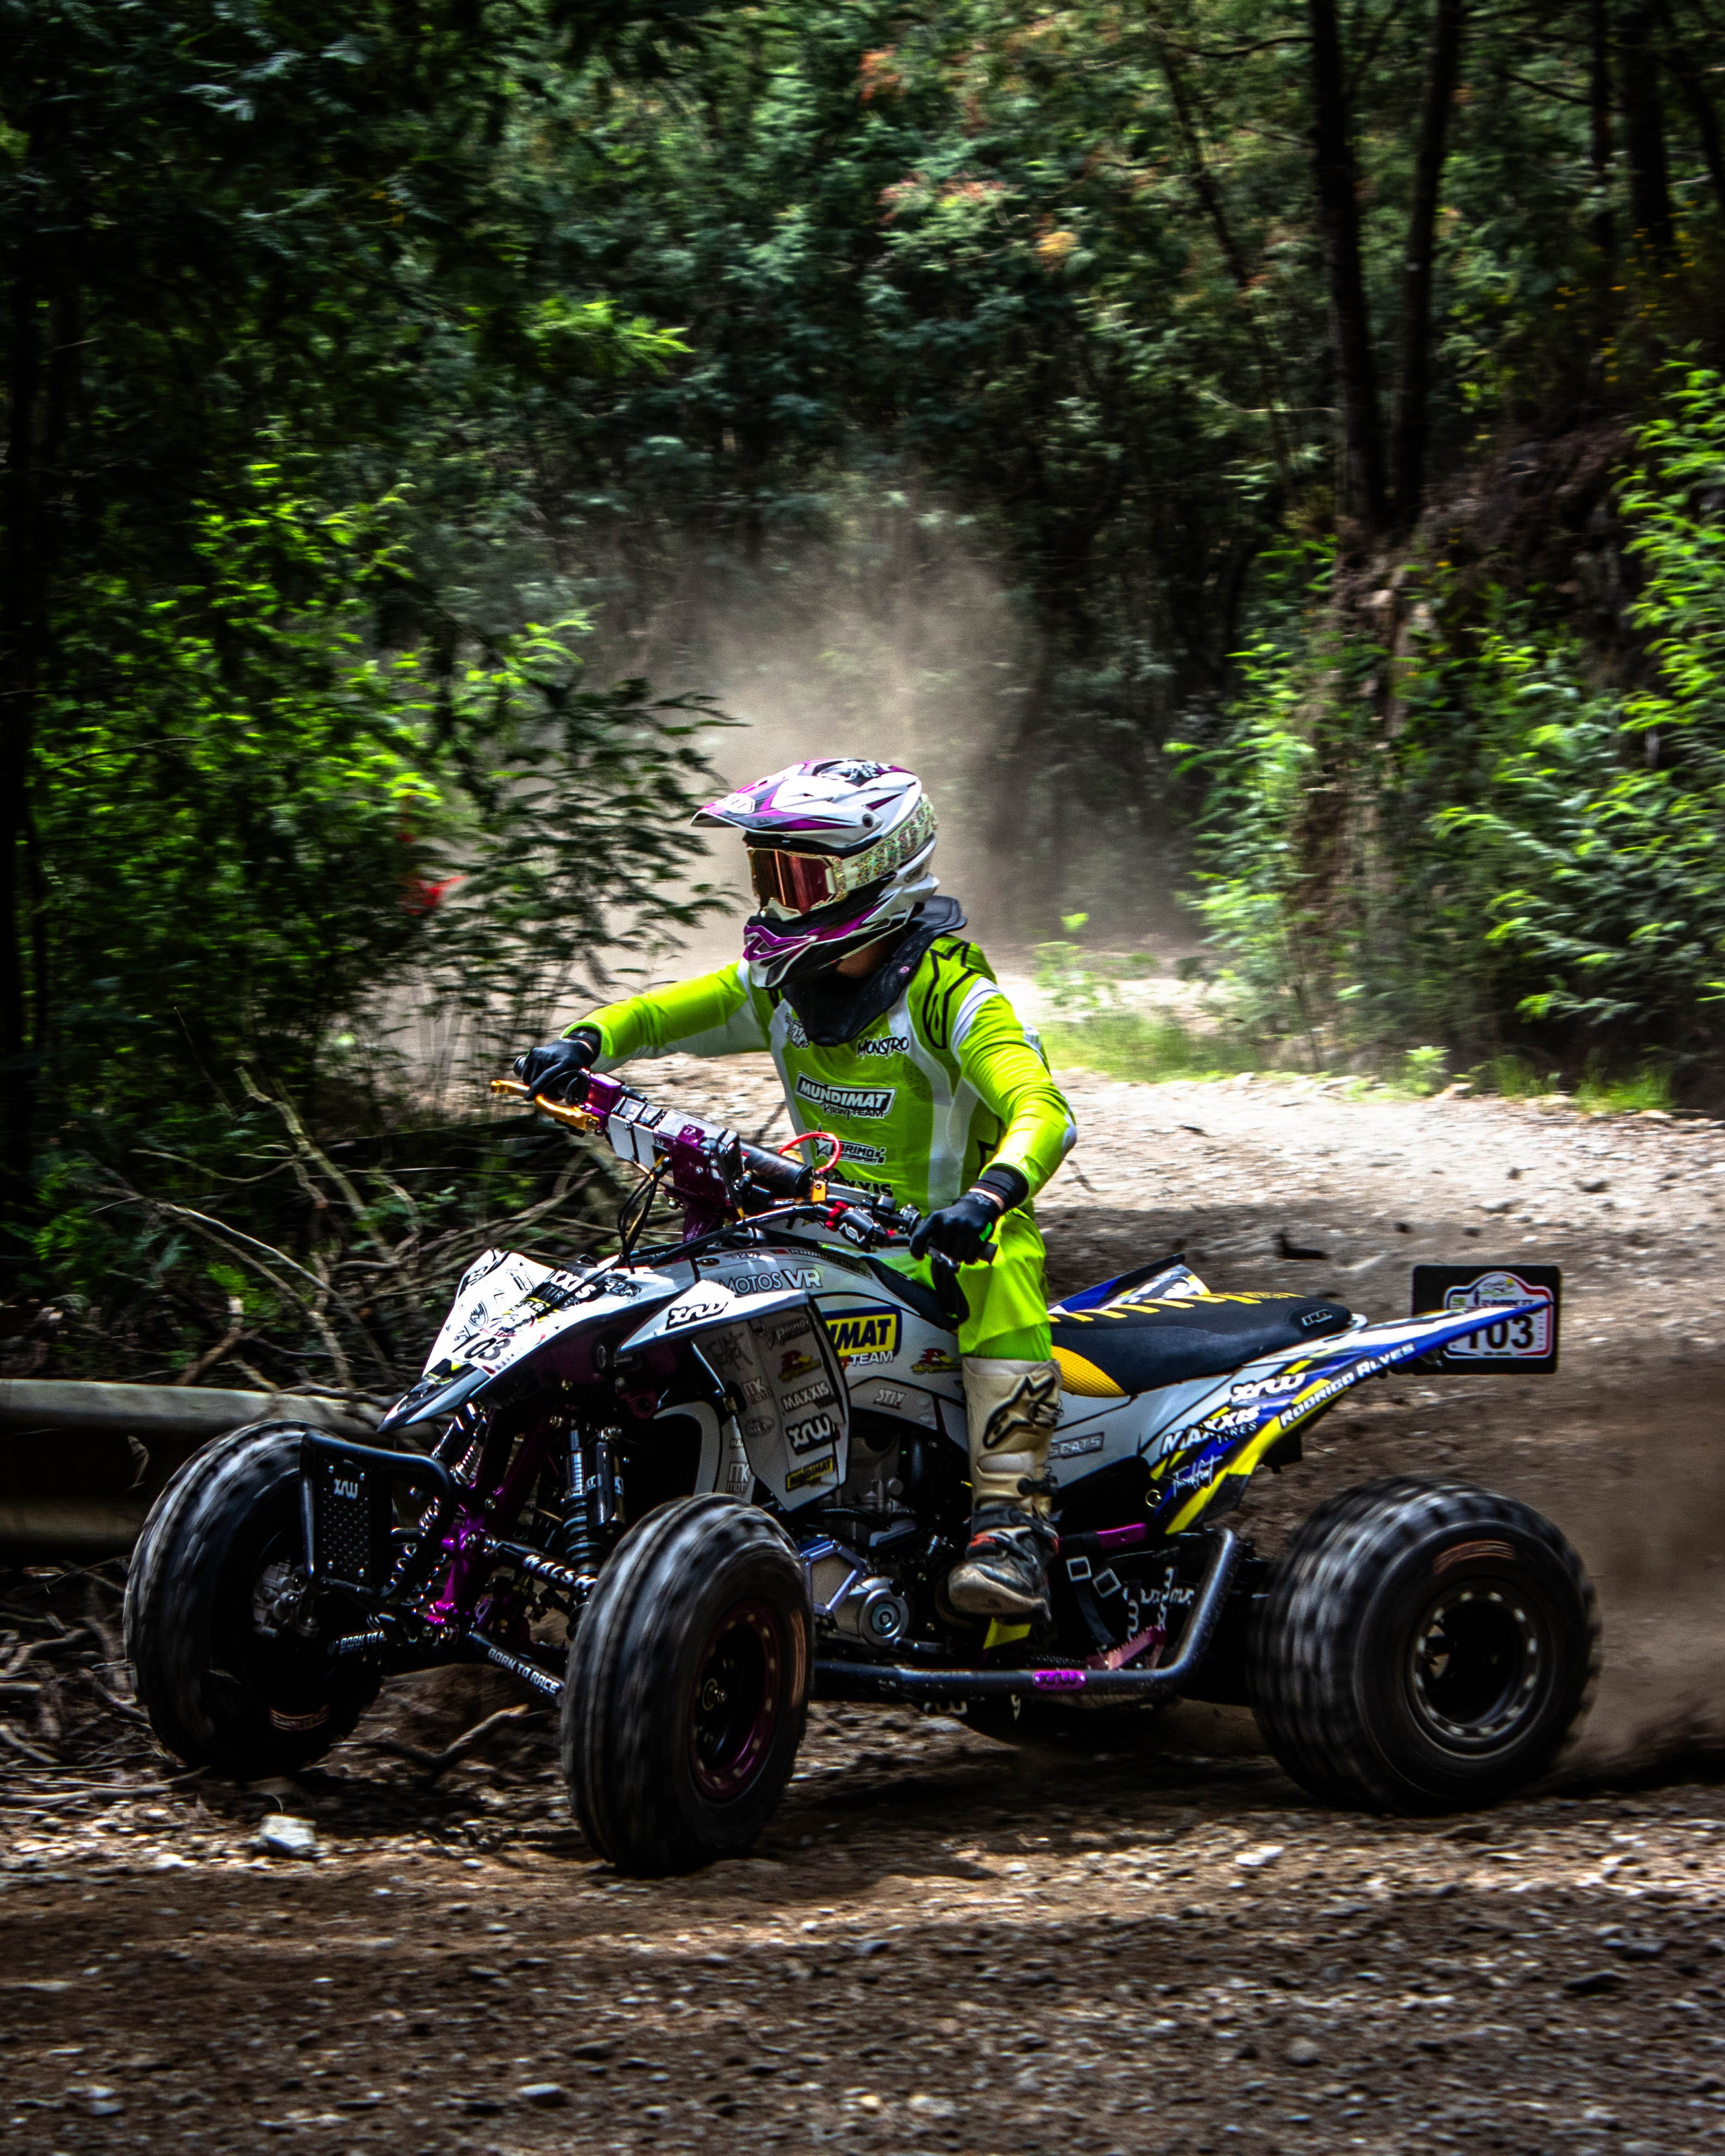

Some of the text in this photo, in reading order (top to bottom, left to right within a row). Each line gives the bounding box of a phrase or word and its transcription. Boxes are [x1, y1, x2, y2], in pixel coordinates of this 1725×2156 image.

[857, 1036, 908, 1058] MONSTRO
[801, 1080, 887, 1108] MUNDIMAT
[852, 1108, 884, 1117] TEAM
[842, 1143, 873, 1157] RIMO
[839, 1223, 865, 1243] ASV
[720, 1269, 821, 1294] MOTOS VR
[451, 1332, 511, 1361] 103
[1468, 1315, 1534, 1350] 103
[850, 1350, 895, 1366] TEAM
[782, 1382, 831, 1412] MAXXIS
[1280, 1343, 1415, 1428] RODRIGO ALVES
[1160, 1405, 1261, 1455] MAXXIS
[1217, 1421, 1258, 1444] TIRES
[523, 1554, 598, 1591] WALSH
[488, 1648, 560, 1694] BORN TO RACE
